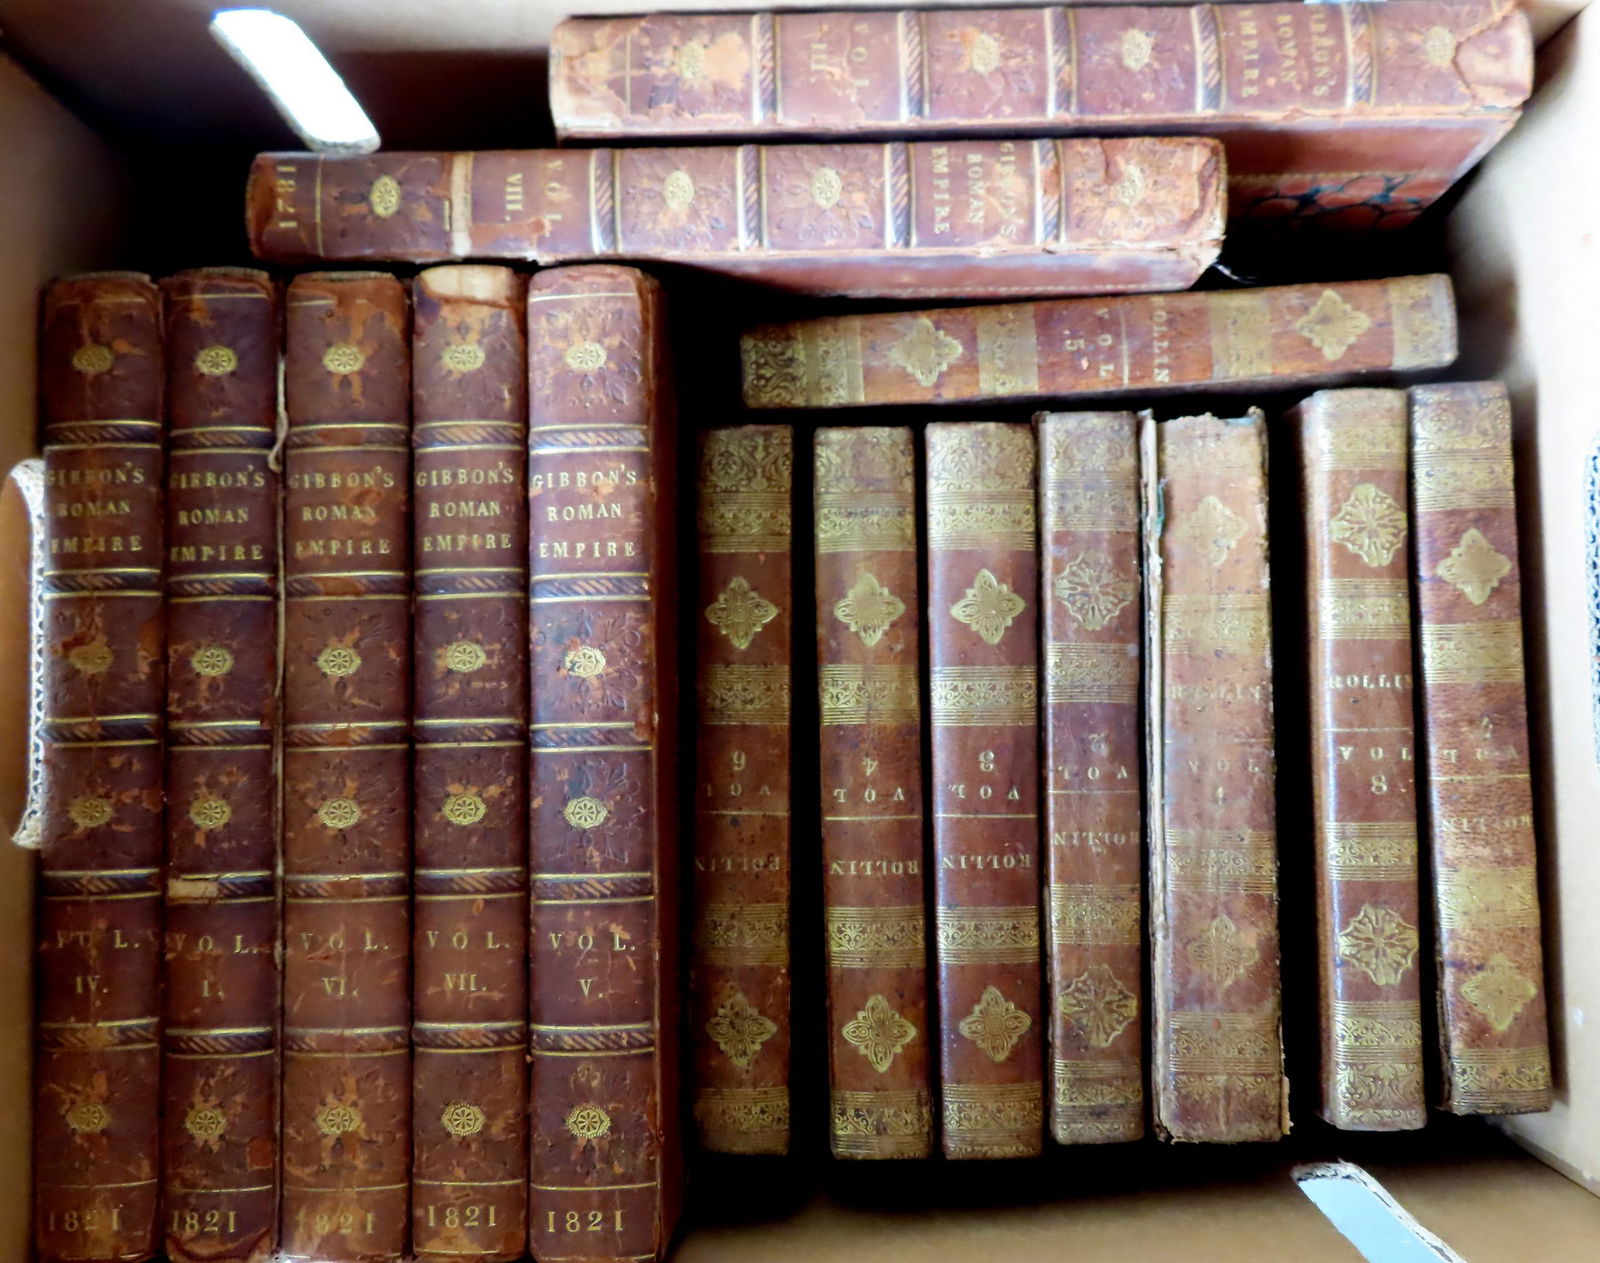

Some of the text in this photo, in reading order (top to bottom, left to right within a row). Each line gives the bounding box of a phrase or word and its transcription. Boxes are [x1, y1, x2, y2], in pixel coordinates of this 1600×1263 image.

[931, 146, 950, 234] EMPIRE
[966, 153, 985, 224] ROMAN
[1065, 338, 1085, 351] 5
[1152, 297, 1171, 383] ROLLIN
[288, 465, 394, 489] GIBBON'S
[416, 462, 514, 487] GIBBON'S
[532, 463, 637, 489] GIBBON'S
[58, 500, 131, 518] ROMAN
[178, 507, 249, 526] ROMAN
[303, 505, 377, 521] ROMAN
[430, 501, 500, 518] ROMAN
[547, 503, 622, 522] ROMAN
[51, 536, 143, 555] EMPIRE
[295, 539, 391, 555] EMPIRE
[423, 534, 512, 552] EMPIRE
[538, 541, 636, 559] EMPIRE
[170, 545, 264, 562] EMPIRE
[732, 750, 747, 770] 6
[862, 757, 879, 777] 4
[1371, 774, 1388, 796] 8
[830, 860, 919, 876] ROLLIN
[942, 854, 1032, 871] ROLLIN
[174, 933, 259, 954] VOL.
[301, 929, 389, 952] VOL.
[426, 930, 511, 950] VOL.
[550, 932, 636, 952] VOL.
[76, 975, 109, 994] IV.
[322, 976, 359, 997] VI.
[444, 973, 488, 993] VII.
[579, 978, 604, 999] V.
[49, 1206, 121, 1232] 1821
[171, 1209, 237, 1234] 1821
[427, 1205, 498, 1229] 1821
[546, 1210, 624, 1233] 1821
